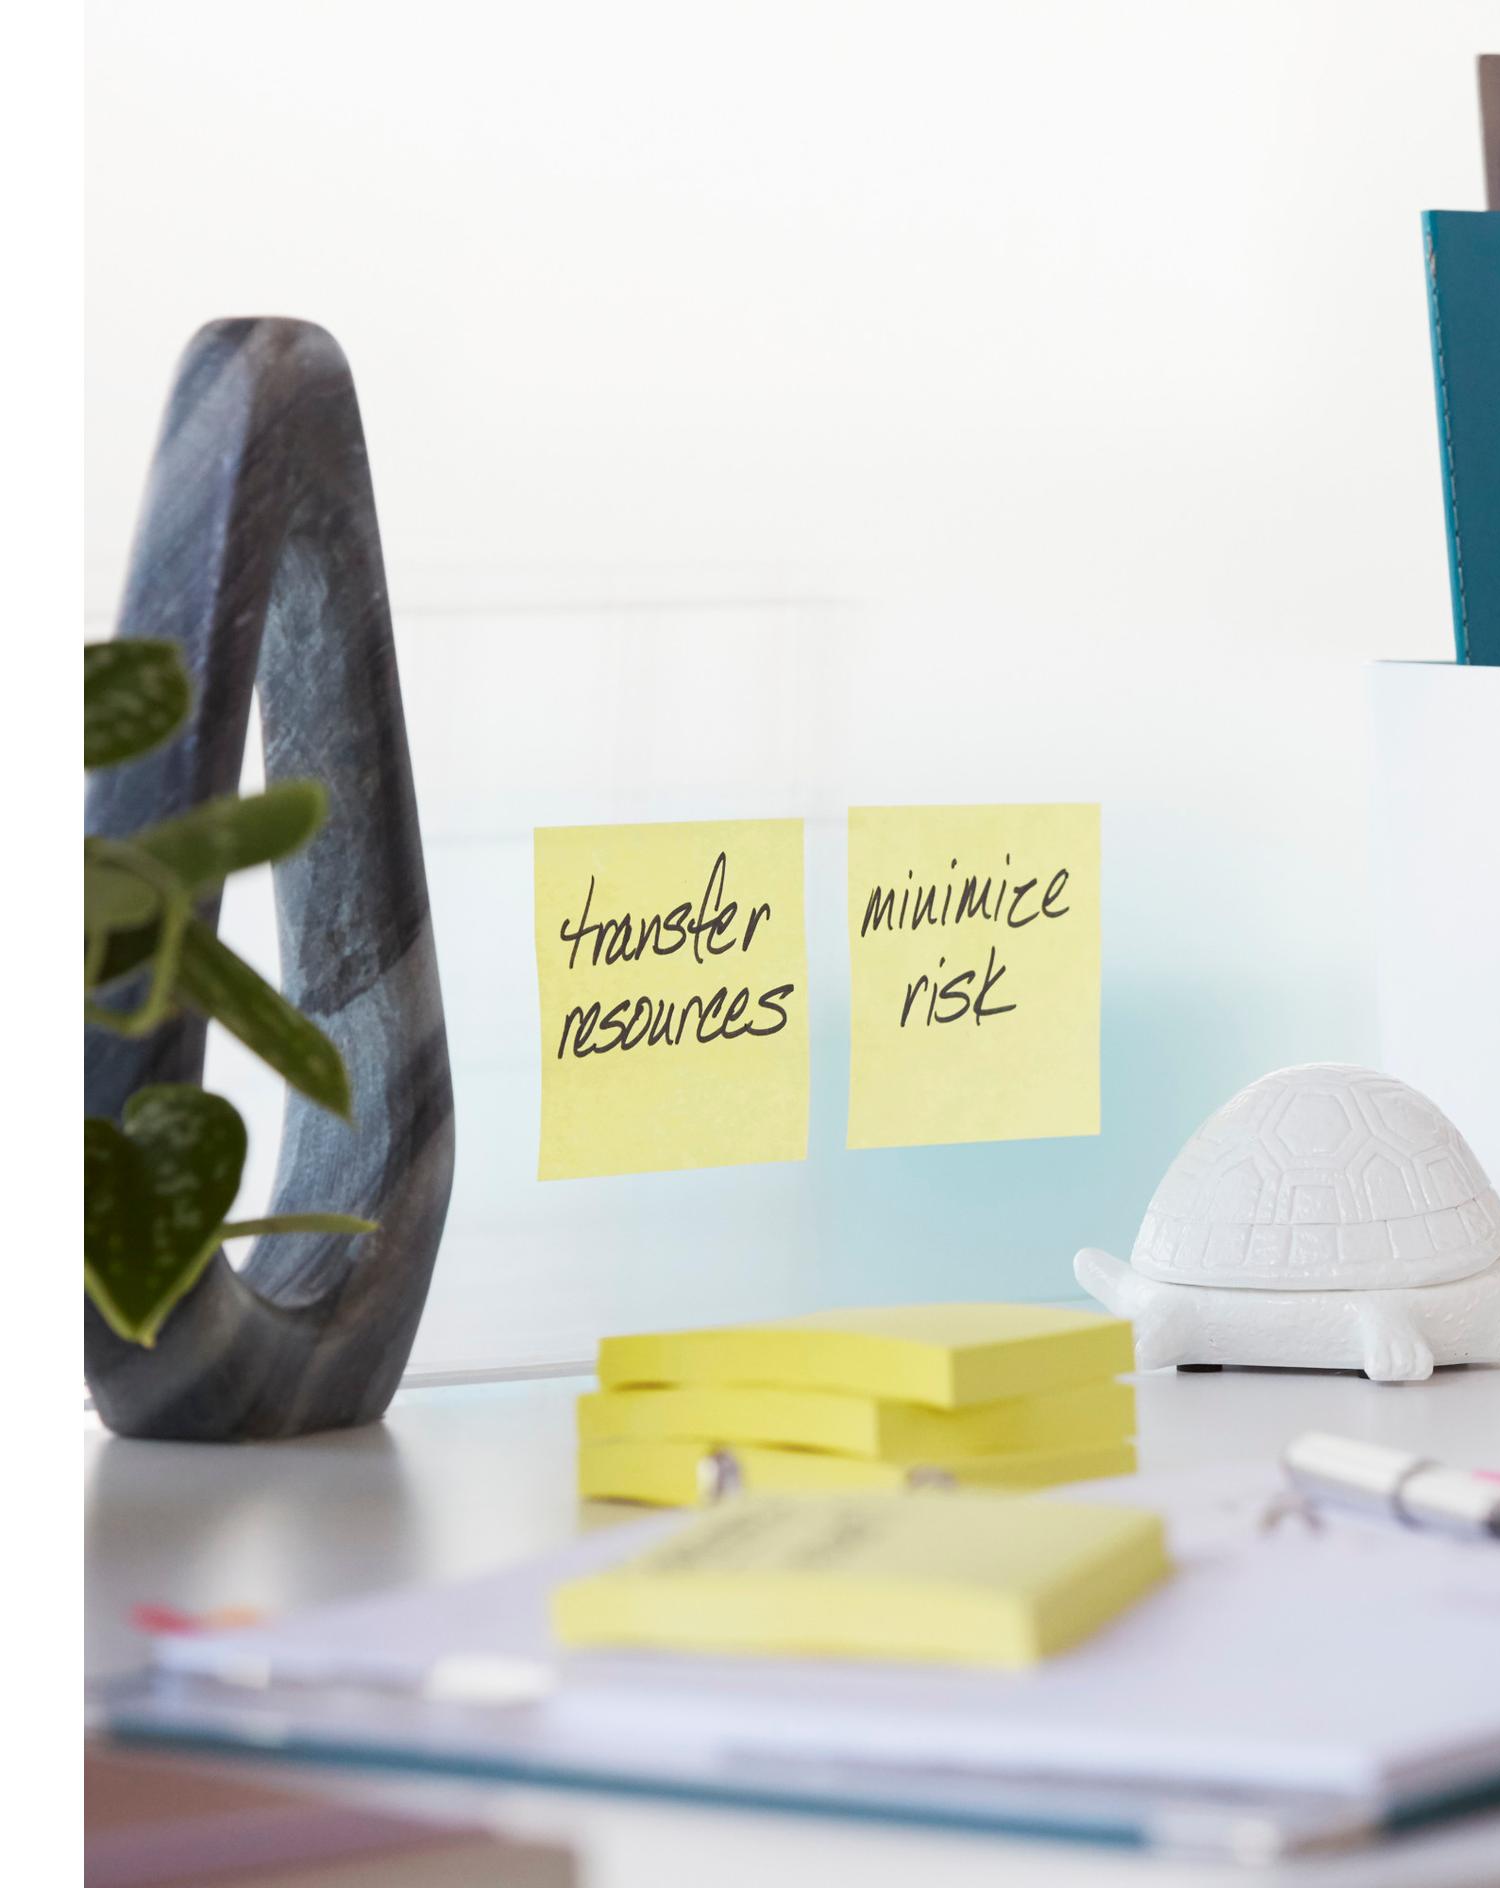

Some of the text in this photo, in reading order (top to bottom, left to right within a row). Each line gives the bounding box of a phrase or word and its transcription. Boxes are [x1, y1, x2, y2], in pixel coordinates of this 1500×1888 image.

[560, 851, 770, 969] transfer
[861, 853, 1069, 938] minimize
[558, 984, 794, 1059] resources
[900, 946, 1016, 1027] risk
